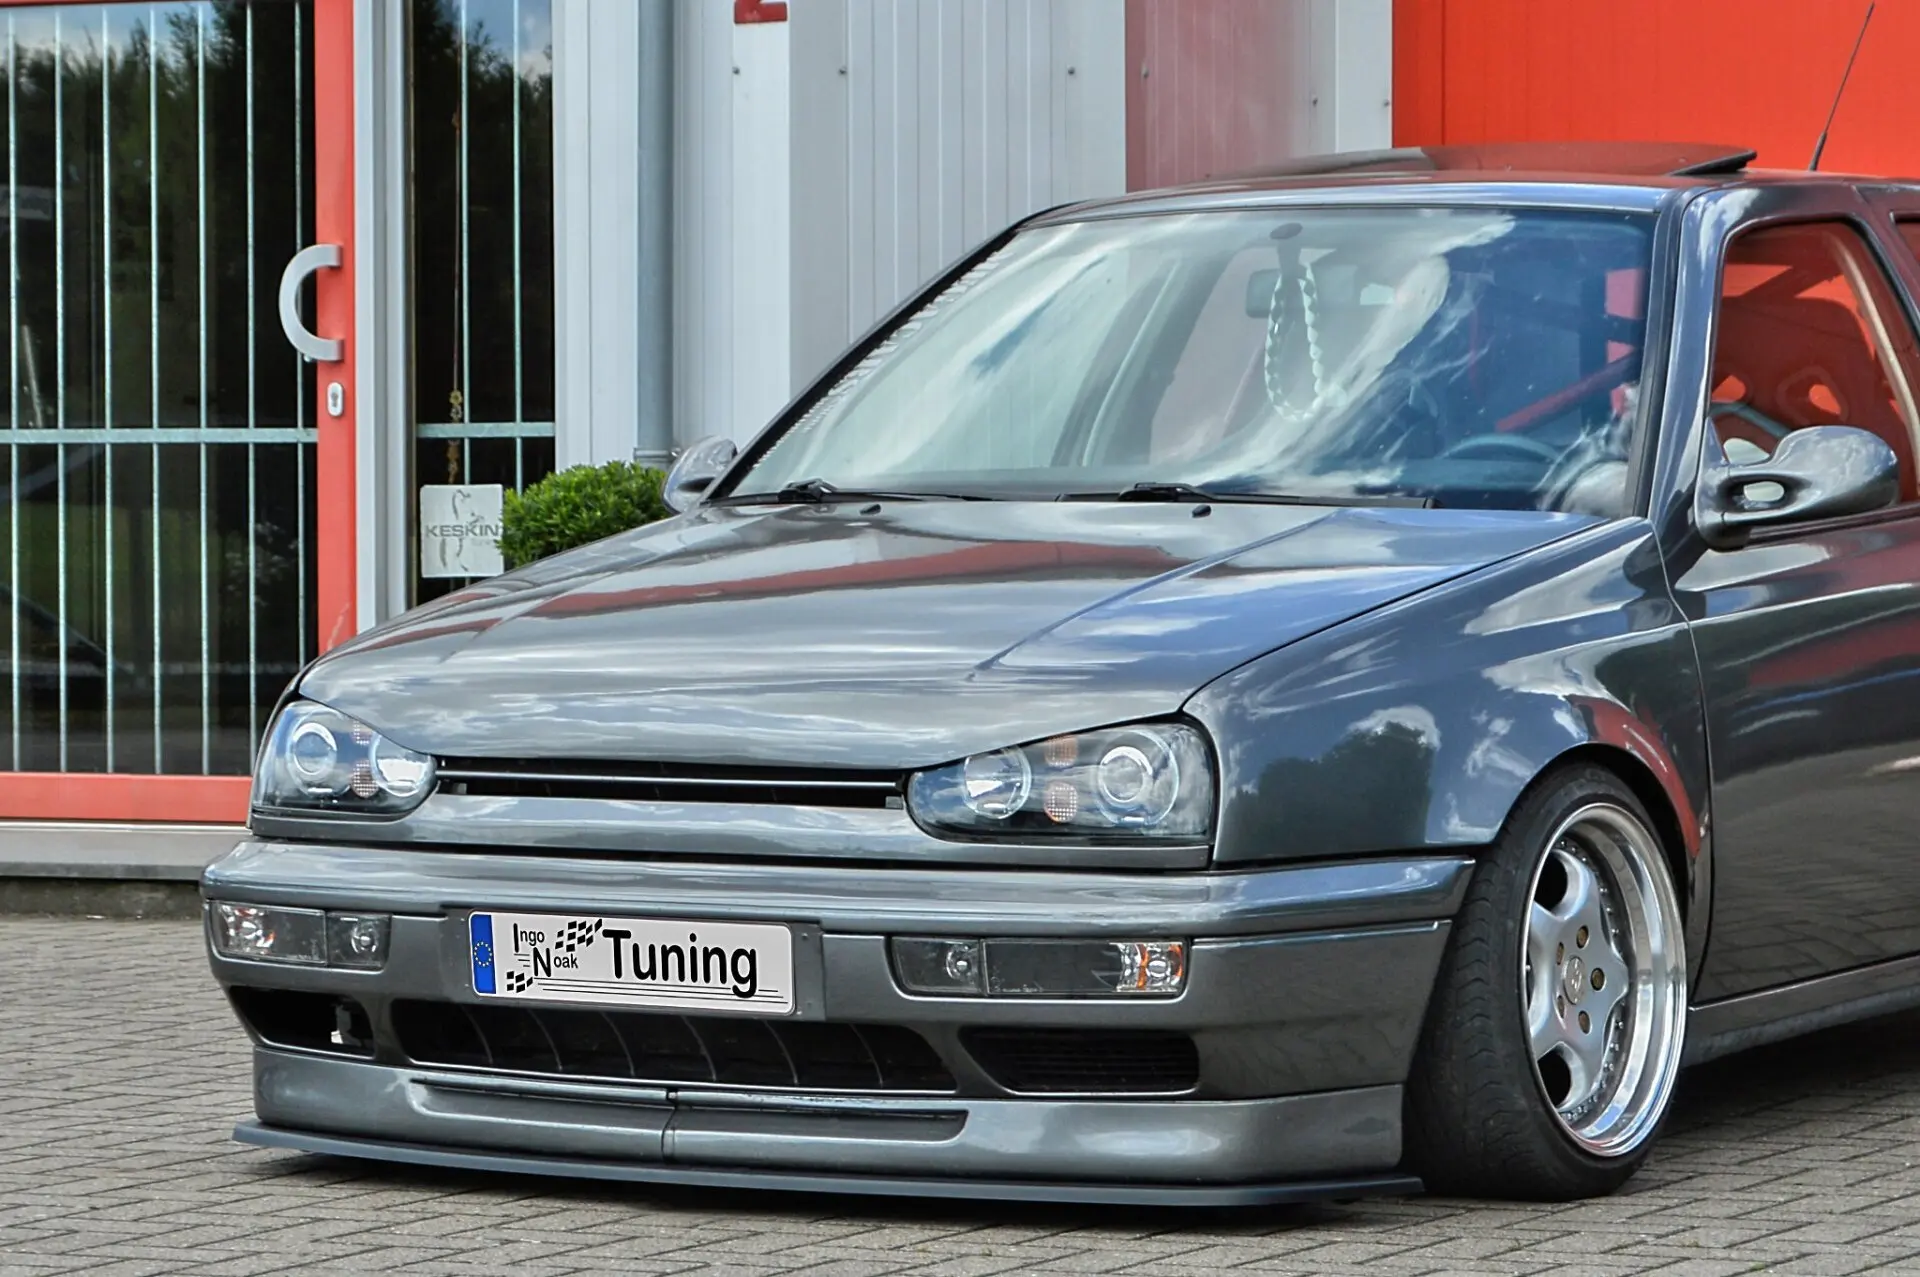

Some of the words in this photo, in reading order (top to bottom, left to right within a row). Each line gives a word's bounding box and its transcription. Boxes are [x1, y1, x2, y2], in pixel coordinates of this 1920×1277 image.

[425, 524, 499, 537] KESKIN
[513, 923, 546, 953] Ingo
[533, 947, 579, 978] Noak
[602, 928, 757, 999] Tuning
